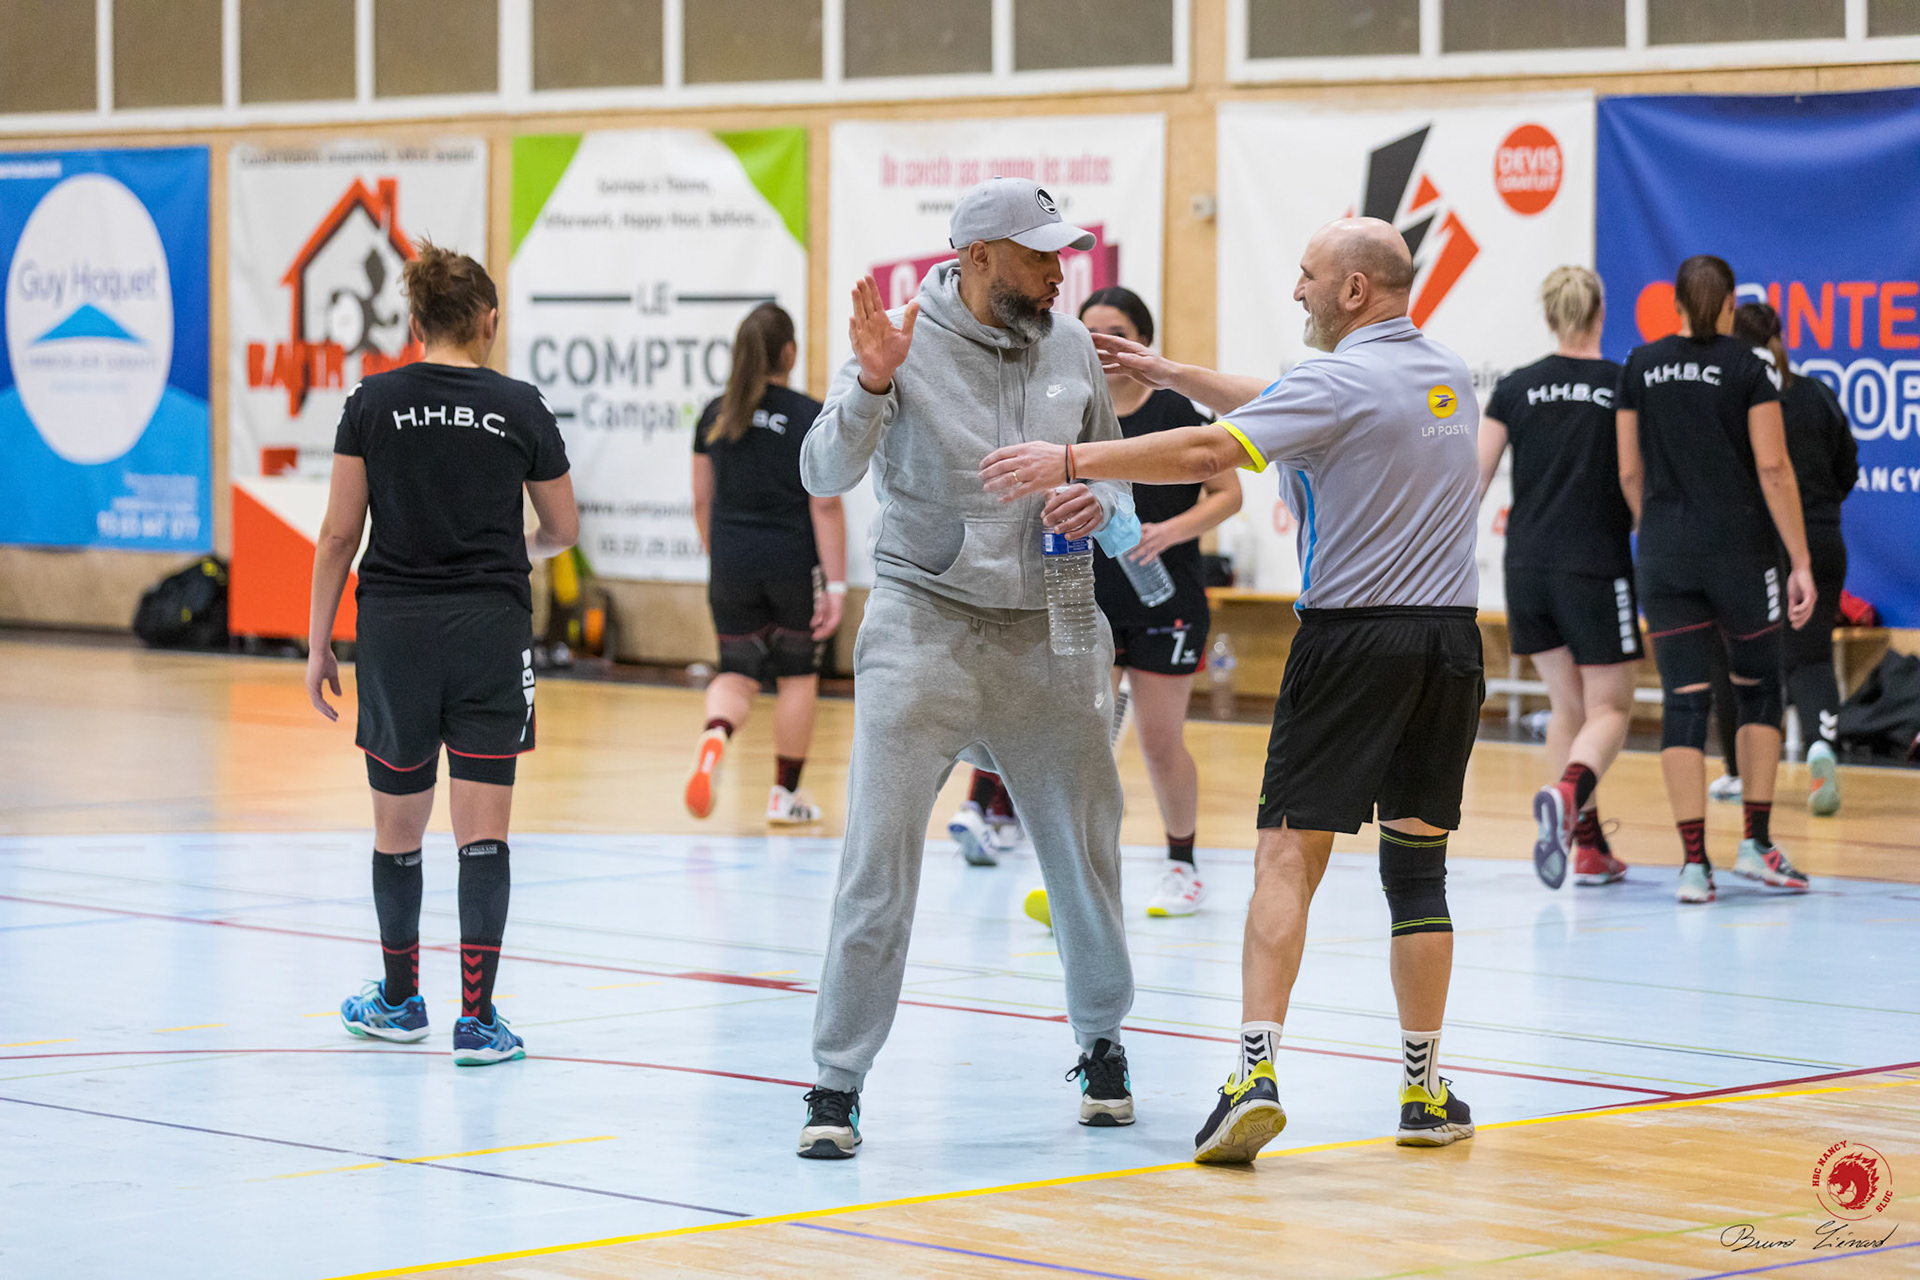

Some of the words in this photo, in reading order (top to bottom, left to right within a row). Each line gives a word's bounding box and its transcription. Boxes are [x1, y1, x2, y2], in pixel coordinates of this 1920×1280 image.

[1499, 145, 1558, 174] DEVIS
[18, 260, 66, 308] Guy
[71, 262, 157, 304] Hoquet
[637, 282, 670, 315] LE
[530, 336, 733, 389] COMPTO
[392, 405, 506, 437] H.H.B.C.
[1421, 426, 1435, 437] LA
[1438, 424, 1470, 436] POSTE
[1855, 465, 1920, 493] ANCY
[1170, 631, 1187, 664] 7
[1424, 1102, 1447, 1120] HOKA
